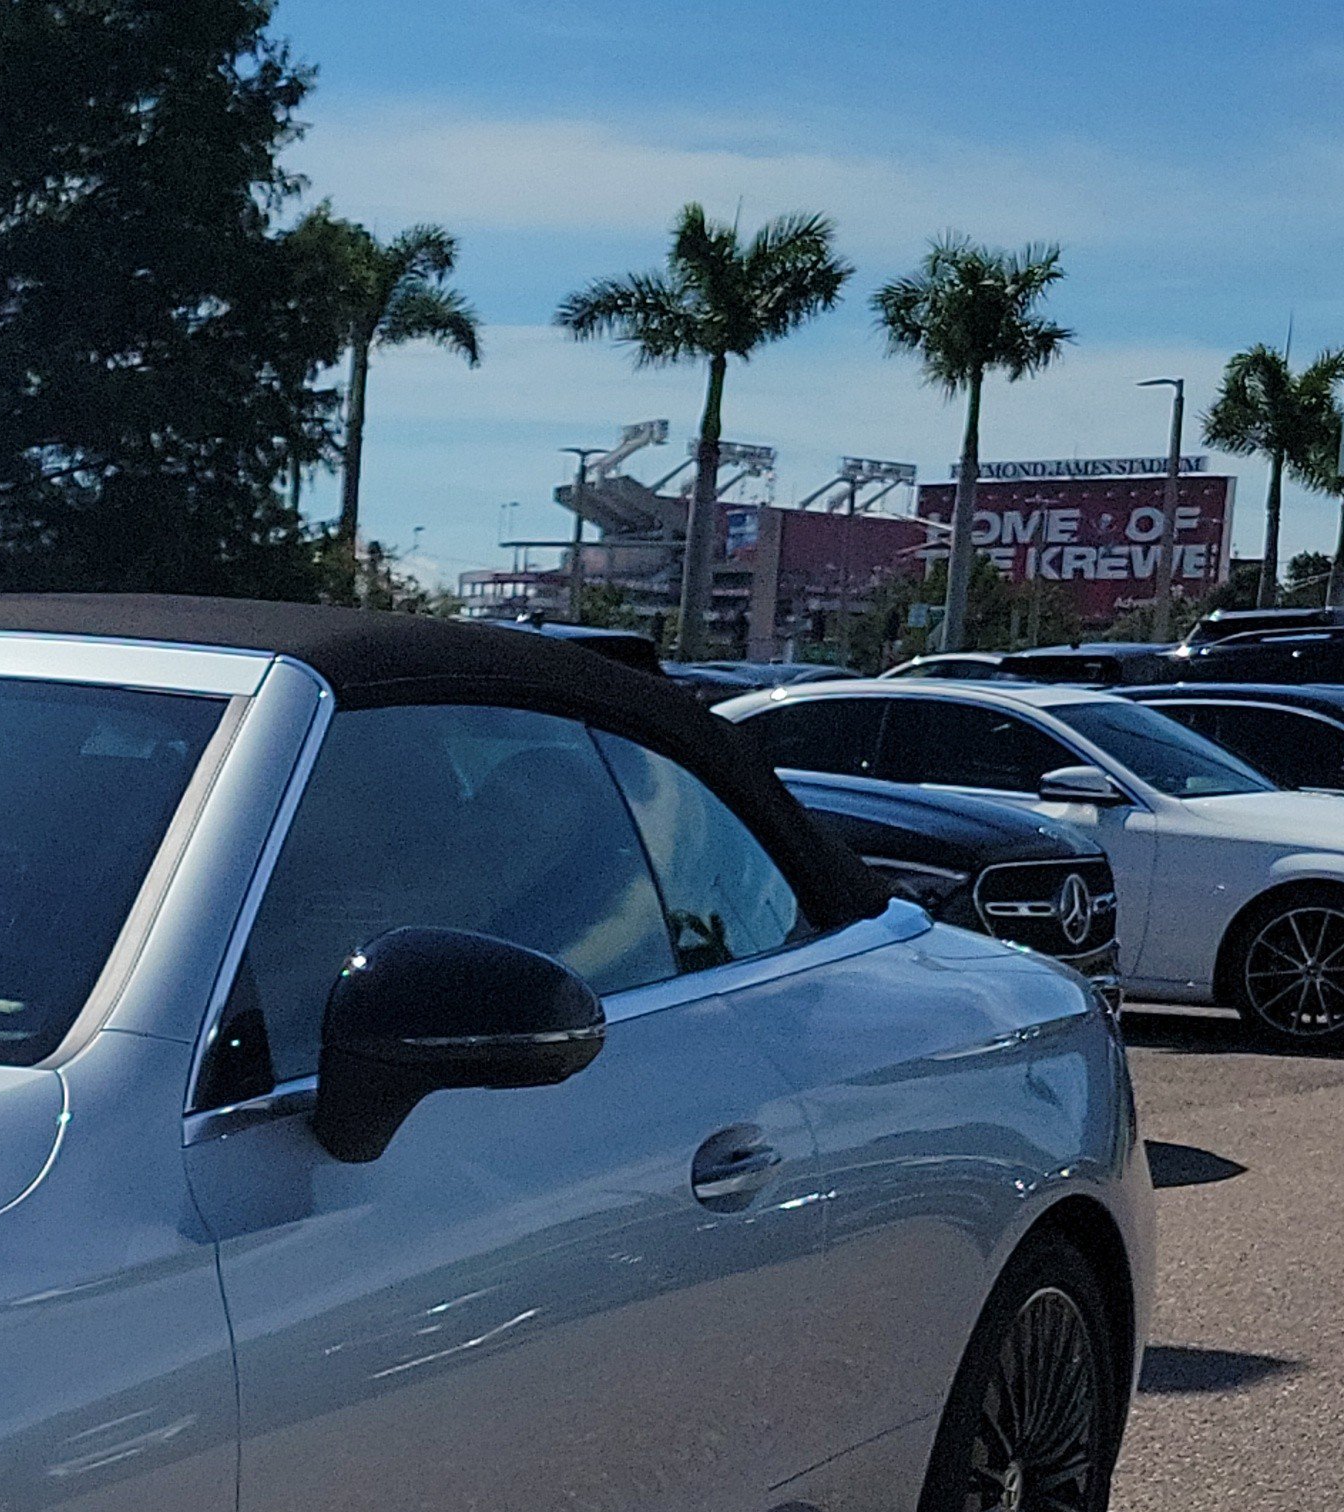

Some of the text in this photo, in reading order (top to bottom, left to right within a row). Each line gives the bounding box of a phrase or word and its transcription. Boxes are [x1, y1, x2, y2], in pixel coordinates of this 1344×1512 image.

[1048, 459, 1112, 477] JAMES
[1125, 506, 1201, 542] OF
[914, 545, 1218, 582] TE KREWE
